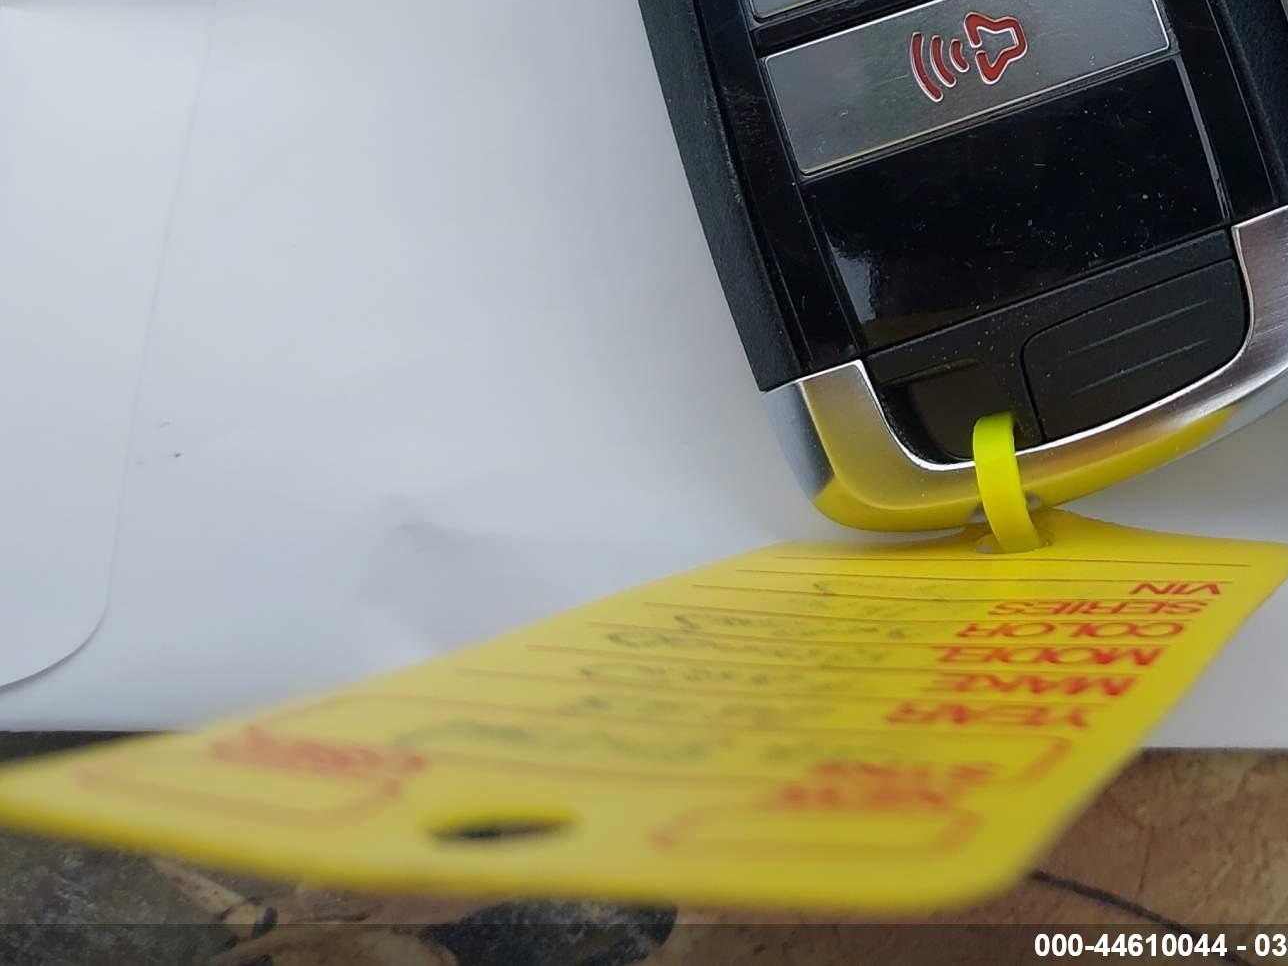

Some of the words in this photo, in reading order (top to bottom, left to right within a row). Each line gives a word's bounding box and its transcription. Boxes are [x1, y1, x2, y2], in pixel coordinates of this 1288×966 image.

[1130, 581, 1222, 595] VIN
[988, 600, 1208, 616] SERIES
[955, 621, 1185, 638] COLOR
[928, 644, 1165, 666] MODEL
[917, 671, 1138, 697] MAKE
[885, 700, 1089, 728] YEAR
